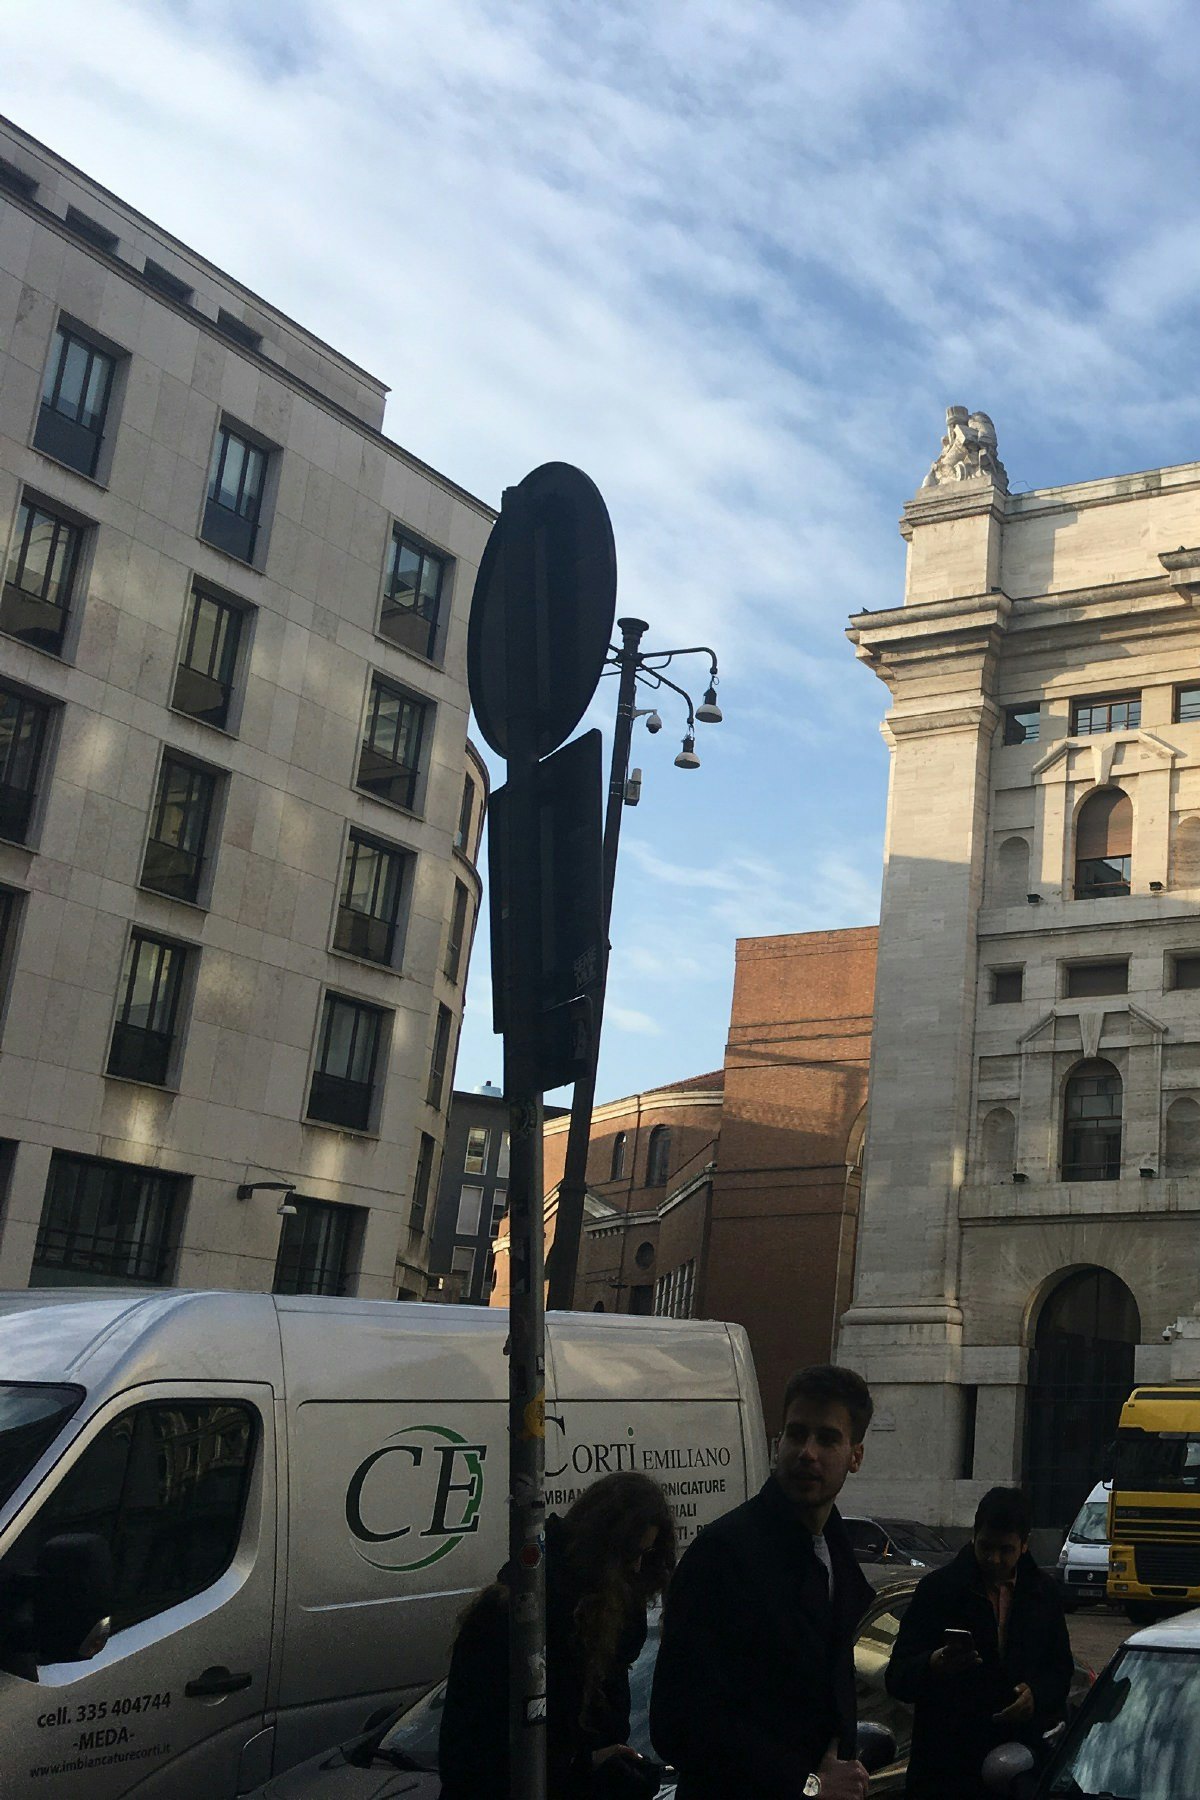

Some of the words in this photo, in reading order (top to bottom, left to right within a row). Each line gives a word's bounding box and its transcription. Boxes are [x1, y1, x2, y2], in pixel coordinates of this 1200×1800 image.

[643, 1447, 731, 1470] EMILIANO
[661, 1479, 726, 1497] RNICIATURE
[37, 1706, 72, 1729] cell.
[76, 1702, 107, 1723] 335
[110, 1692, 172, 1717] 404744
[29, 1743, 171, 1778] www.imbiancaturecorti.it
